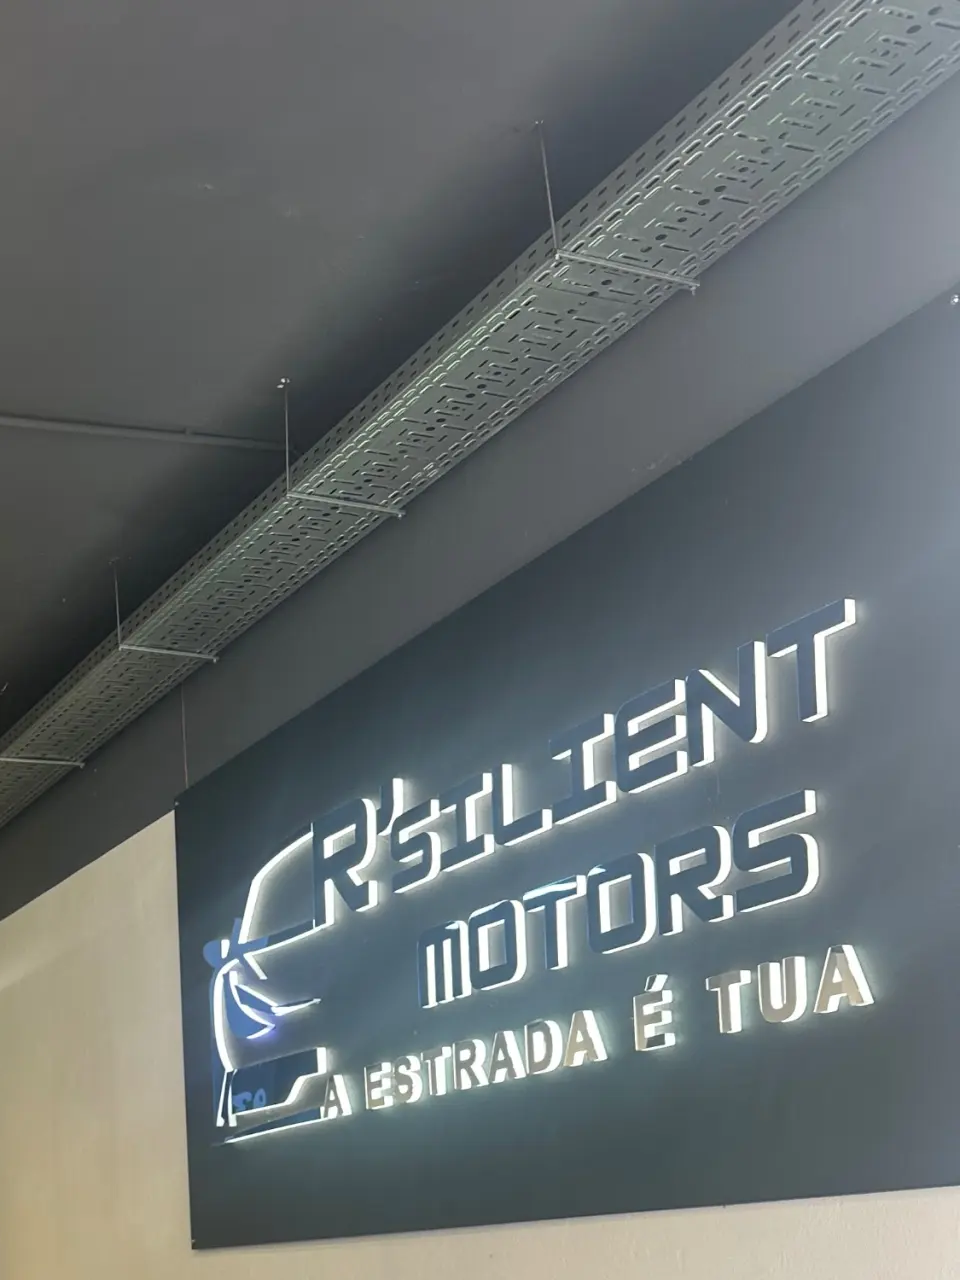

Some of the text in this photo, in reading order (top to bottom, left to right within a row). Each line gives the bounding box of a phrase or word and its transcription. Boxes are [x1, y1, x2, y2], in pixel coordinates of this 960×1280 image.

[310, 597, 856, 928] R'SILIENT
[416, 788, 818, 1010] MOTORS
[320, 943, 875, 1120] A ESTRADA É TUA
